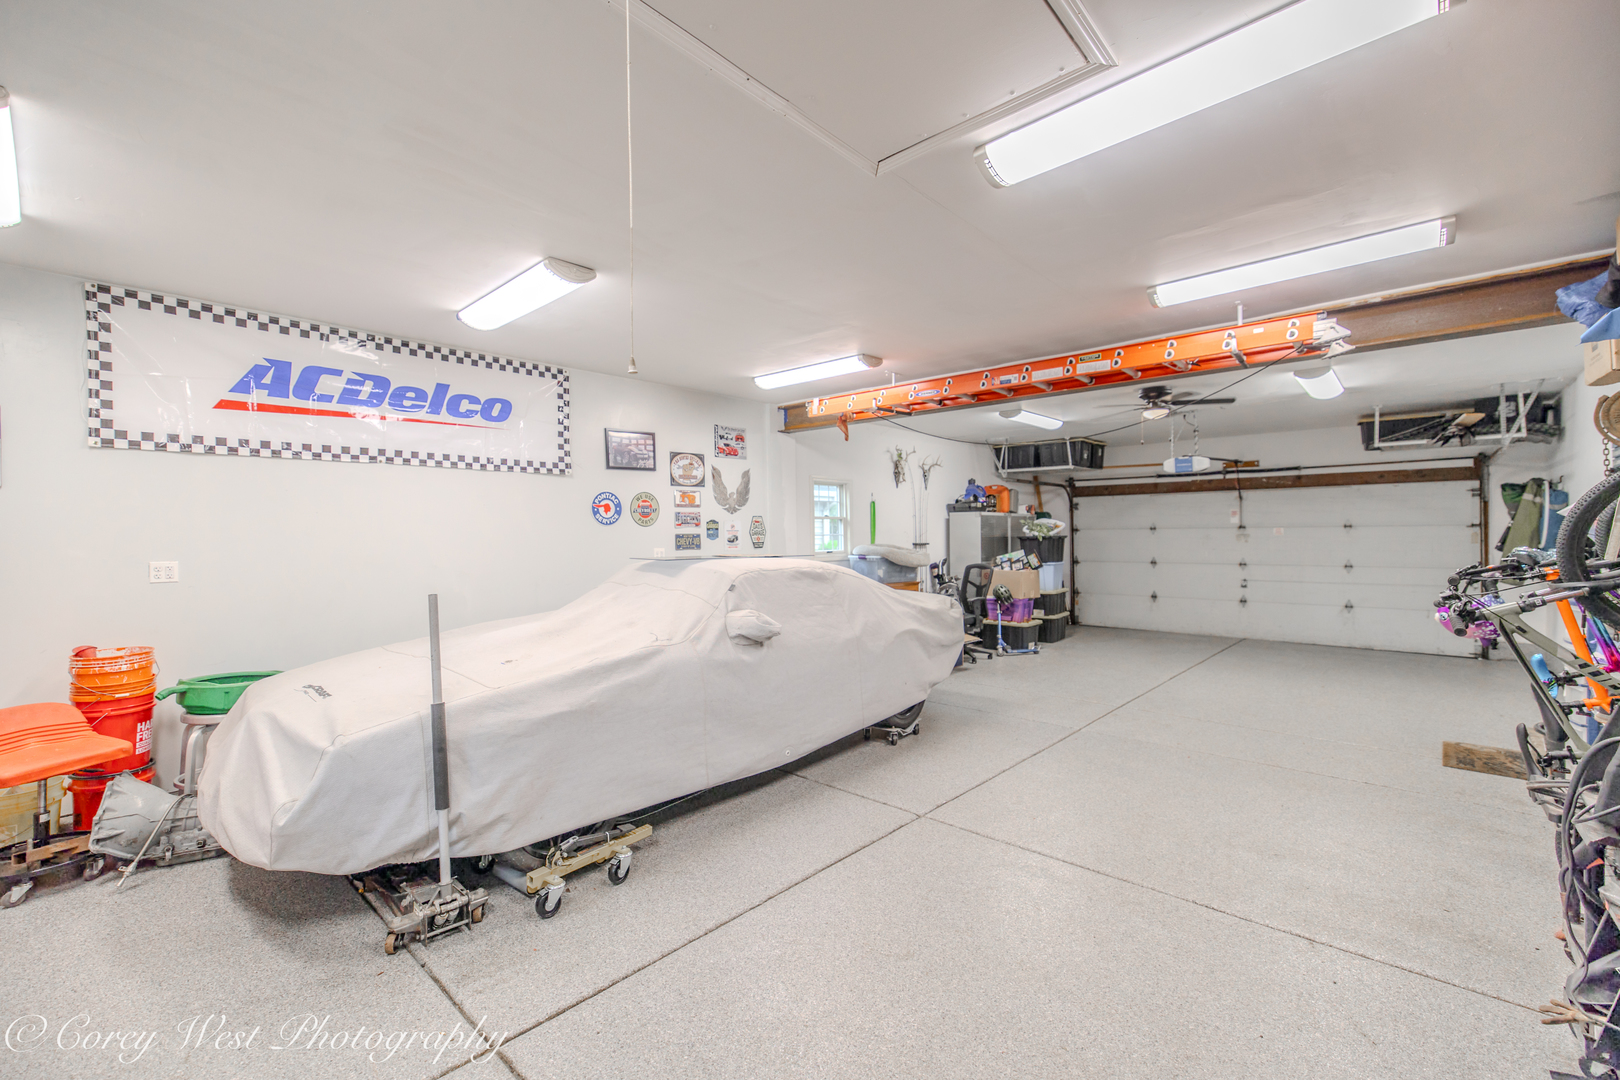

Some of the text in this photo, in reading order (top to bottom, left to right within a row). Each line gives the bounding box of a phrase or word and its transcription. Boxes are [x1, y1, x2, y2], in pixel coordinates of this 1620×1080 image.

[228, 357, 513, 423] ACDelco
[594, 492, 619, 505] PONTIAC
[635, 494, 654, 502] WE USE
[594, 513, 619, 525] SERVICE
[637, 517, 654, 525] PARTS
